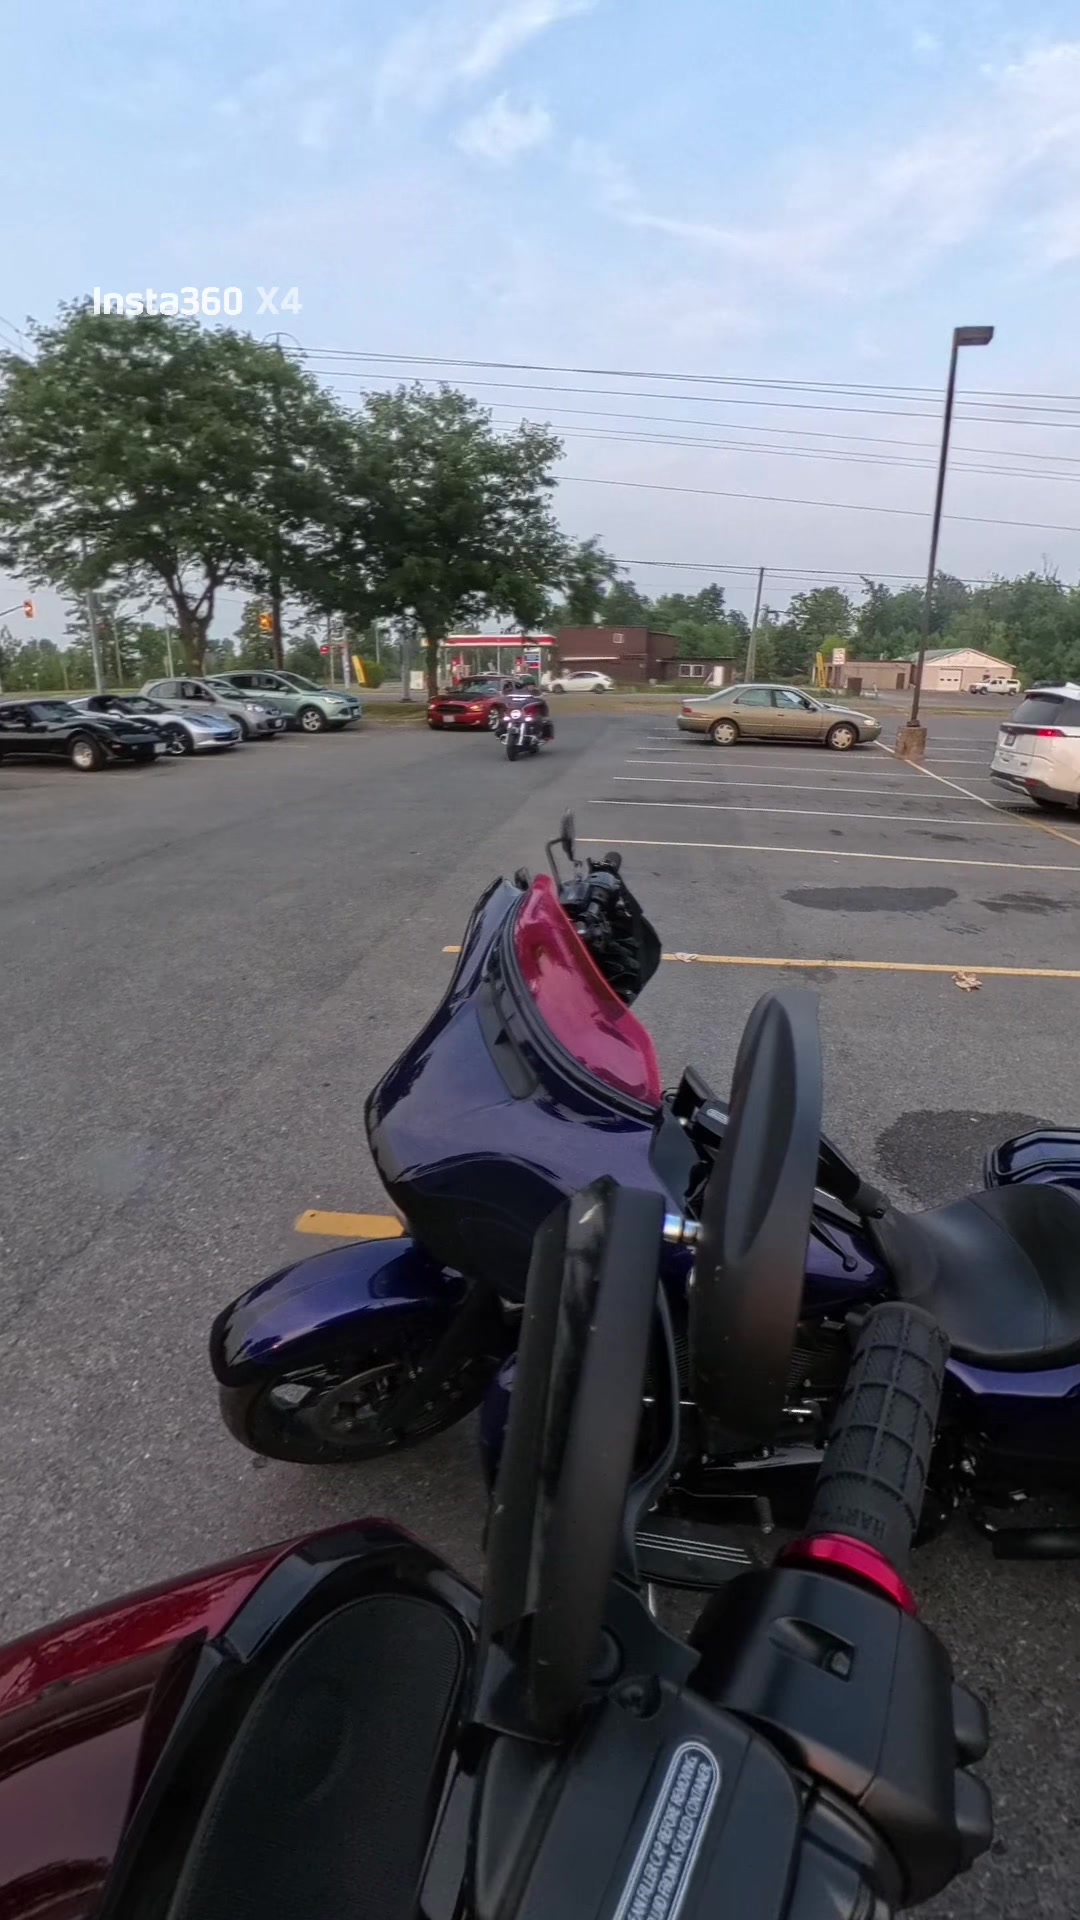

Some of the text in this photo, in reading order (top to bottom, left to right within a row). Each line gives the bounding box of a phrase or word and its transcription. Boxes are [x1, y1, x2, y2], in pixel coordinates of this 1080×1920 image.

[670, 1754, 698, 1806] REMOVING
[656, 1802, 681, 1845] BEFORE
[657, 1861, 679, 1898] FROM
[671, 1815, 695, 1856] SEALED
[684, 1761, 711, 1819] CONTAINER
[648, 1839, 666, 1866] CAP
[636, 1862, 660, 1900] FILLER
